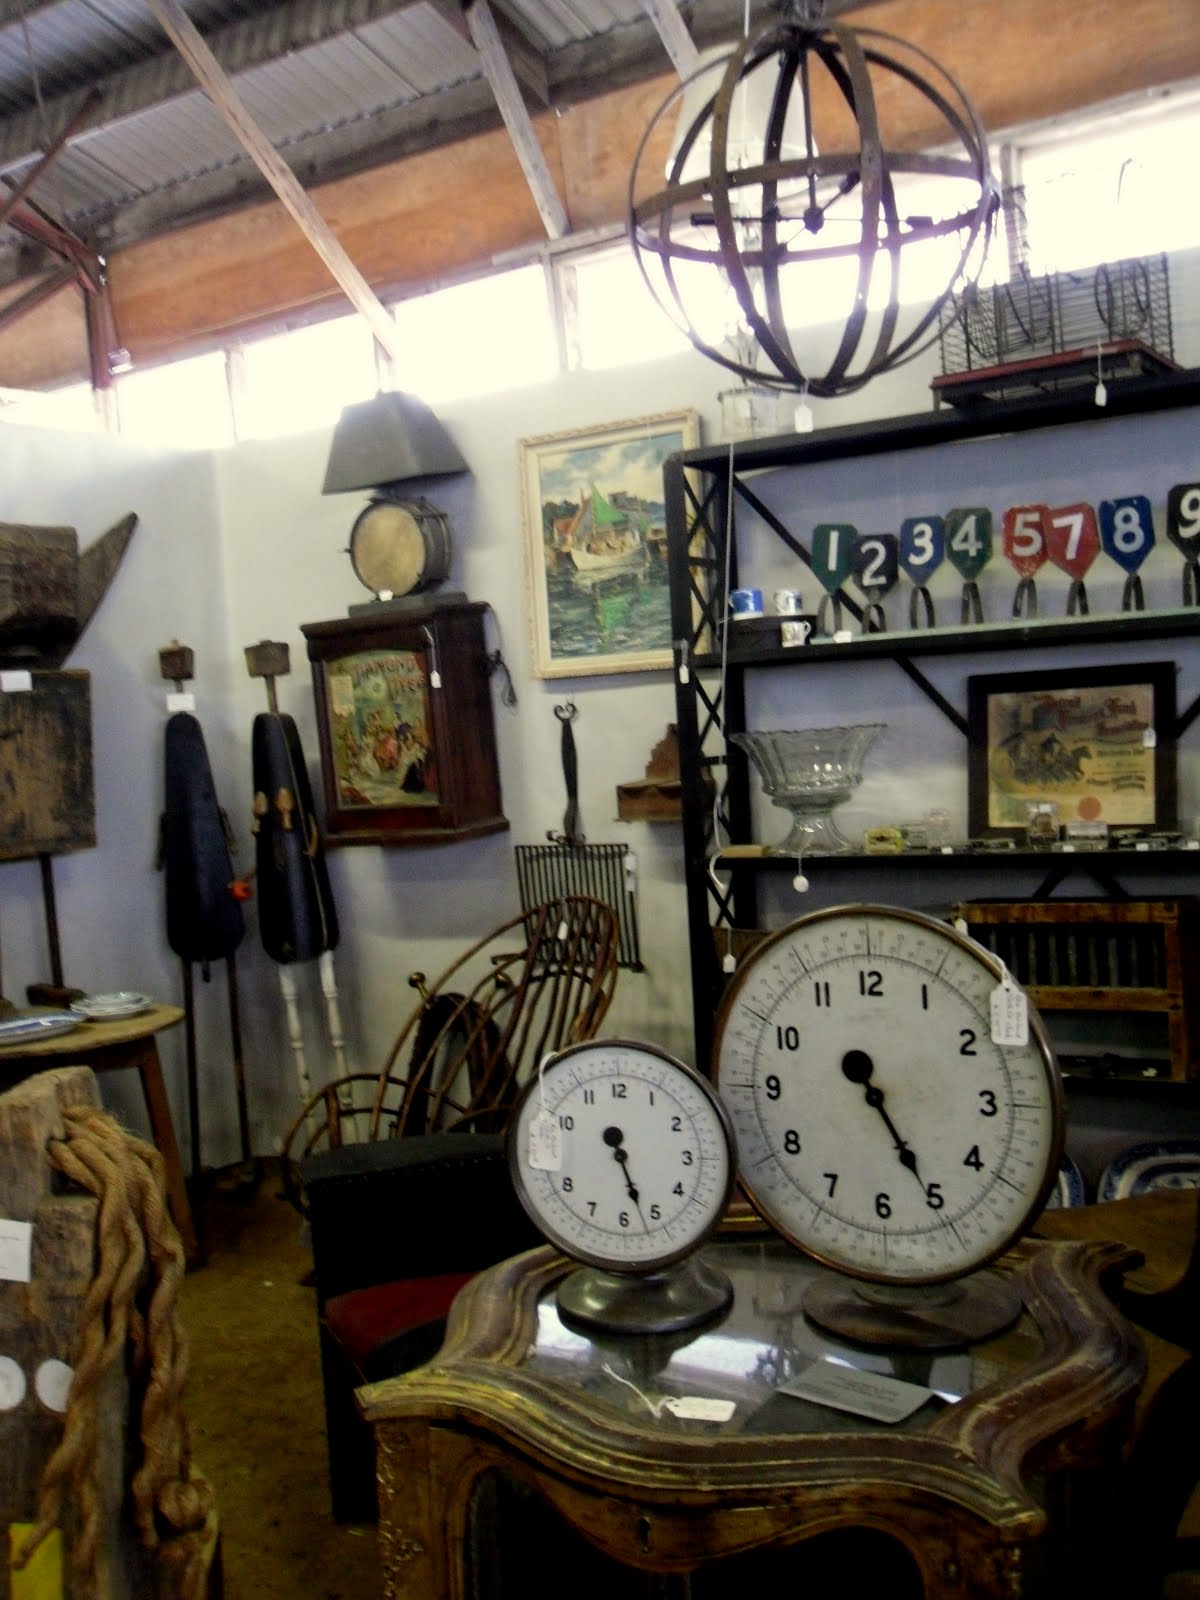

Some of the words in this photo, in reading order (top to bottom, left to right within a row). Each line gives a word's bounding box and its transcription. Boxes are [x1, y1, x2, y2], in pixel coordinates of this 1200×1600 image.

[1178, 488, 1200, 539] 9
[951, 513, 983, 557] 4
[1012, 511, 1042, 557] 5
[1052, 513, 1084, 560] 7
[1113, 506, 1145, 553] 8
[827, 530, 840, 571] 1
[908, 522, 934, 566] 3
[860, 540, 887, 587] 2
[814, 981, 831, 1008] 11
[858, 970, 884, 997] 12
[921, 983, 929, 1011] 1
[776, 1025, 800, 1052] 10
[959, 1028, 977, 1057] 2
[583, 1089, 595, 1105] 11
[611, 1083, 628, 1099] 12
[649, 1091, 656, 1106] 1
[765, 1074, 781, 1101] 9
[978, 1089, 998, 1118] 3
[559, 1115, 575, 1132] 10
[671, 1116, 682, 1133] 2
[783, 1129, 802, 1156] 8
[682, 1150, 694, 1167] 3
[963, 1144, 985, 1172] 4
[562, 1176, 574, 1193] 8
[672, 1182, 685, 1197] 4
[822, 1172, 839, 1199] 7
[924, 1182, 945, 1211] 5
[586, 1201, 598, 1217] 7
[618, 1211, 630, 1228] 6
[649, 1204, 661, 1221] 5
[874, 1192, 892, 1220] 6
